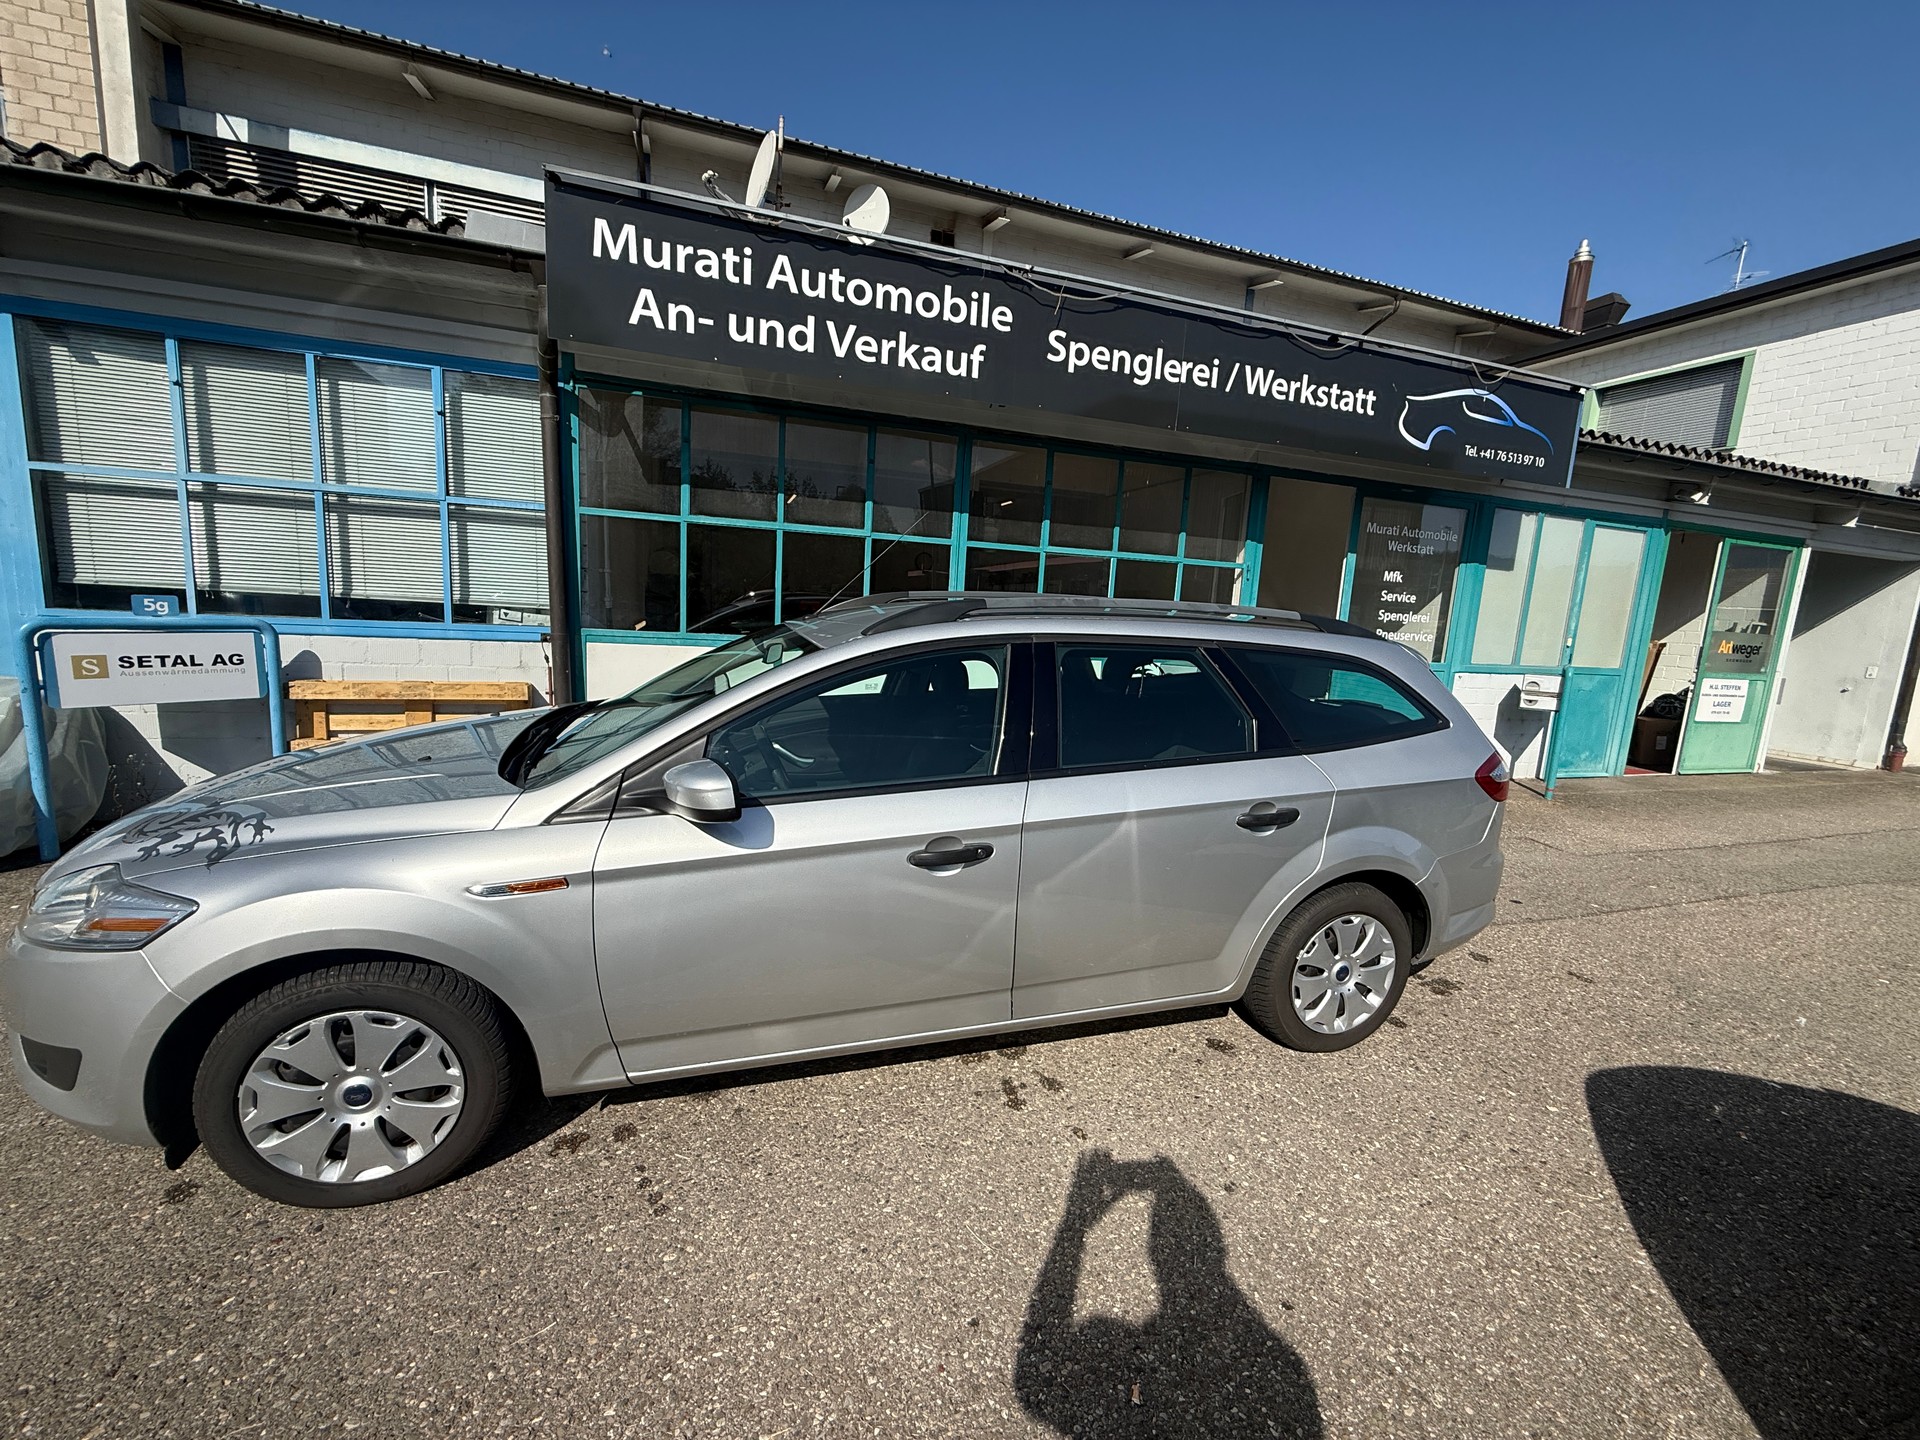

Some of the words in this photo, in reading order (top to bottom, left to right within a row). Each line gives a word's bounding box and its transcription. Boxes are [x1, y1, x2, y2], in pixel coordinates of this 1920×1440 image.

[592, 217, 753, 286] Murati
[765, 254, 1014, 333] Automobile
[628, 287, 714, 335] An-
[728, 314, 816, 354] und
[825, 320, 987, 380] Verkauf
[1046, 329, 1220, 389] Spenglerei
[1244, 364, 1377, 416] Werkstatt
[1465, 445, 1478, 457] Tel.
[1479, 448, 1495, 460] +41
[1496, 450, 1507, 462] 76
[1507, 452, 1522, 464] 513
[1523, 454, 1534, 466] 97
[1535, 456, 1545, 468] 10
[1366, 521, 1400, 536] Murati
[1401, 525, 1458, 542] Automobile
[1387, 540, 1434, 555] Werkstatt
[1383, 570, 1404, 583] Mfk
[1380, 590, 1417, 604] Service
[143, 597, 169, 616] 5g
[1377, 609, 1431, 625] Spenglerei
[80, 658, 101, 676] S
[117, 654, 204, 669] SETAL
[211, 653, 245, 667] AG
[119, 667, 247, 677] Aussenwärmedämmung
